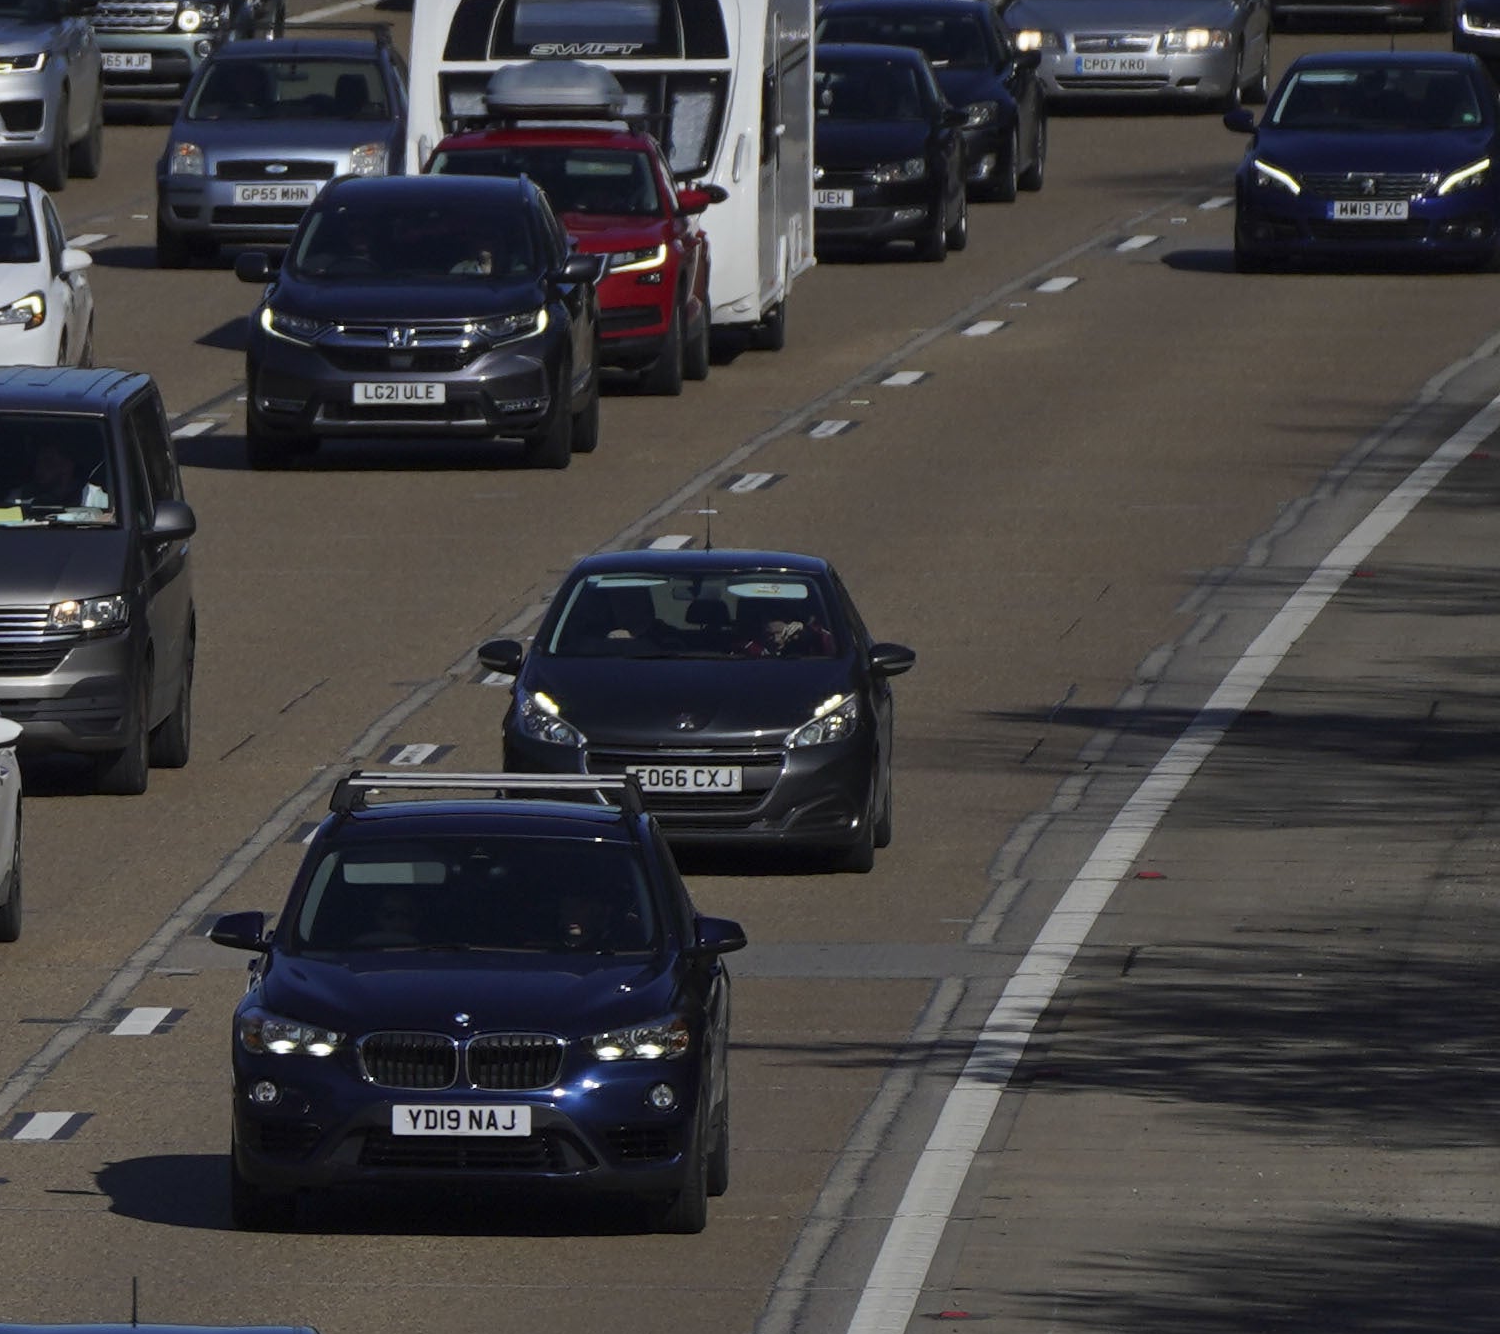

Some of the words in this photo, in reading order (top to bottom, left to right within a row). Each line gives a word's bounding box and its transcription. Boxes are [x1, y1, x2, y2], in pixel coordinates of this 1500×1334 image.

[530, 43, 643, 55] SWIFT
[242, 189, 277, 201] GP55
[1375, 203, 1402, 215] FXC
[363, 385, 399, 400] LG21
[403, 385, 435, 400] ULE
[693, 770, 733, 787] CXJ
[408, 1109, 461, 1131] YD19
[468, 1109, 517, 1130] NAJ
